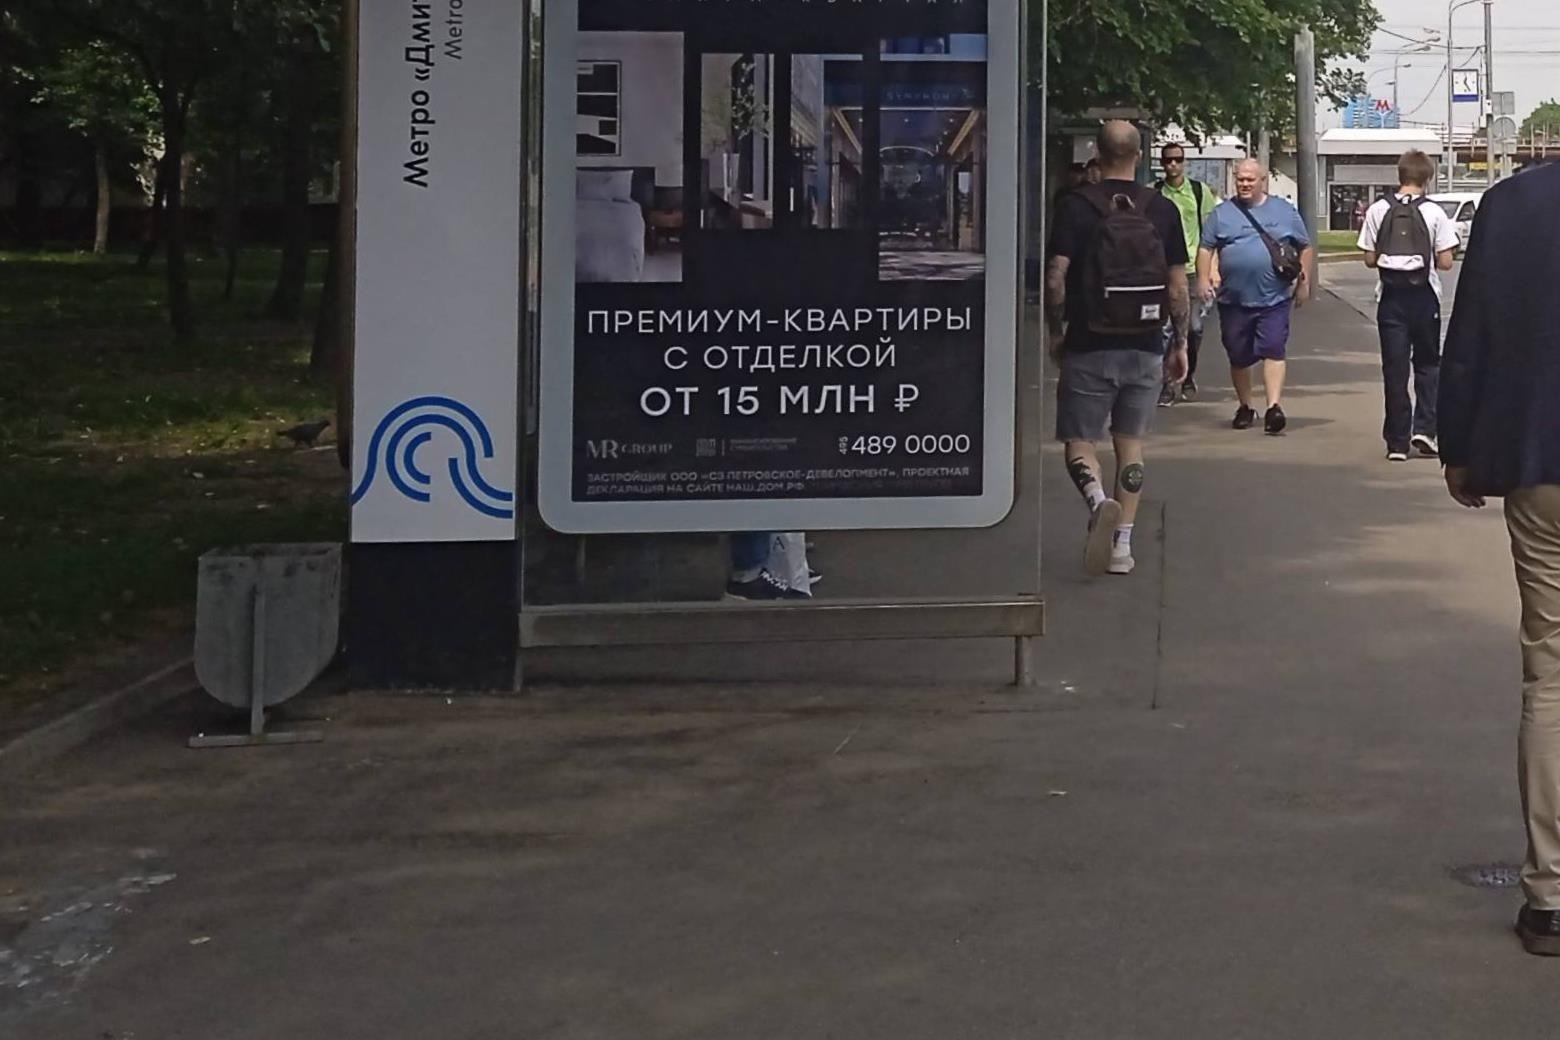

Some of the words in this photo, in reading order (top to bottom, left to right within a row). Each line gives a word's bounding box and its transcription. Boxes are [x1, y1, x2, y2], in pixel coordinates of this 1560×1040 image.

[403, 90, 436, 188] Метро
[588, 306, 971, 334] ПРЕМИУМ-КВАРТИРЫ
[663, 345, 688, 370] С
[703, 337, 896, 373] ОТДЕЛКОЙ
[640, 386, 699, 416] ОТ
[717, 386, 760, 415] 15
[779, 384, 875, 415] МЛН
[850, 435, 897, 455] 489
[904, 434, 971, 454] 0000
[666, 484, 683, 493] НА
[670, 471, 698, 481] ООО
